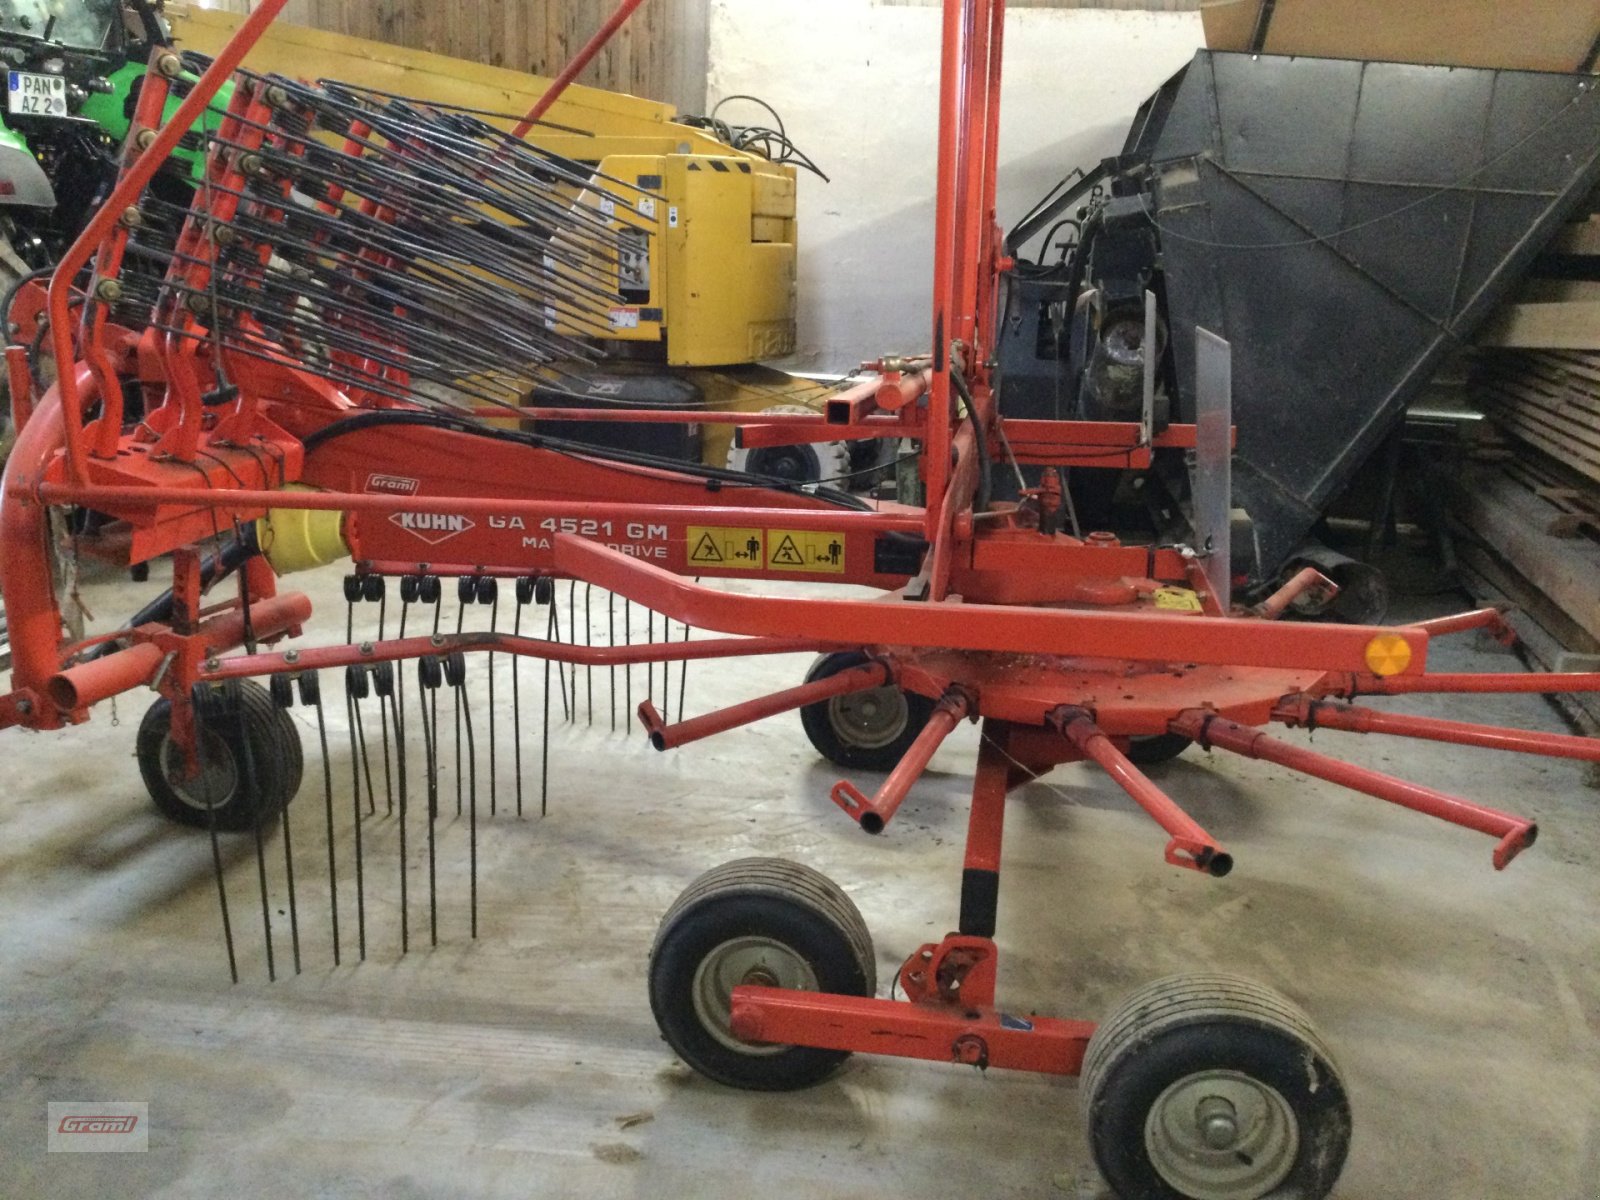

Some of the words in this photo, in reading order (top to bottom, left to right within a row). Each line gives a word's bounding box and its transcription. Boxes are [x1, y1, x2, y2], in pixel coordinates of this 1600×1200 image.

[23, 76, 51, 95] PAN
[22, 95, 39, 113] AZ
[44, 97, 53, 114] 2
[371, 476, 416, 491] Graml
[400, 512, 463, 532] KUHN
[488, 515, 526, 530] GA
[540, 517, 613, 537] 4521
[626, 522, 668, 541] GM
